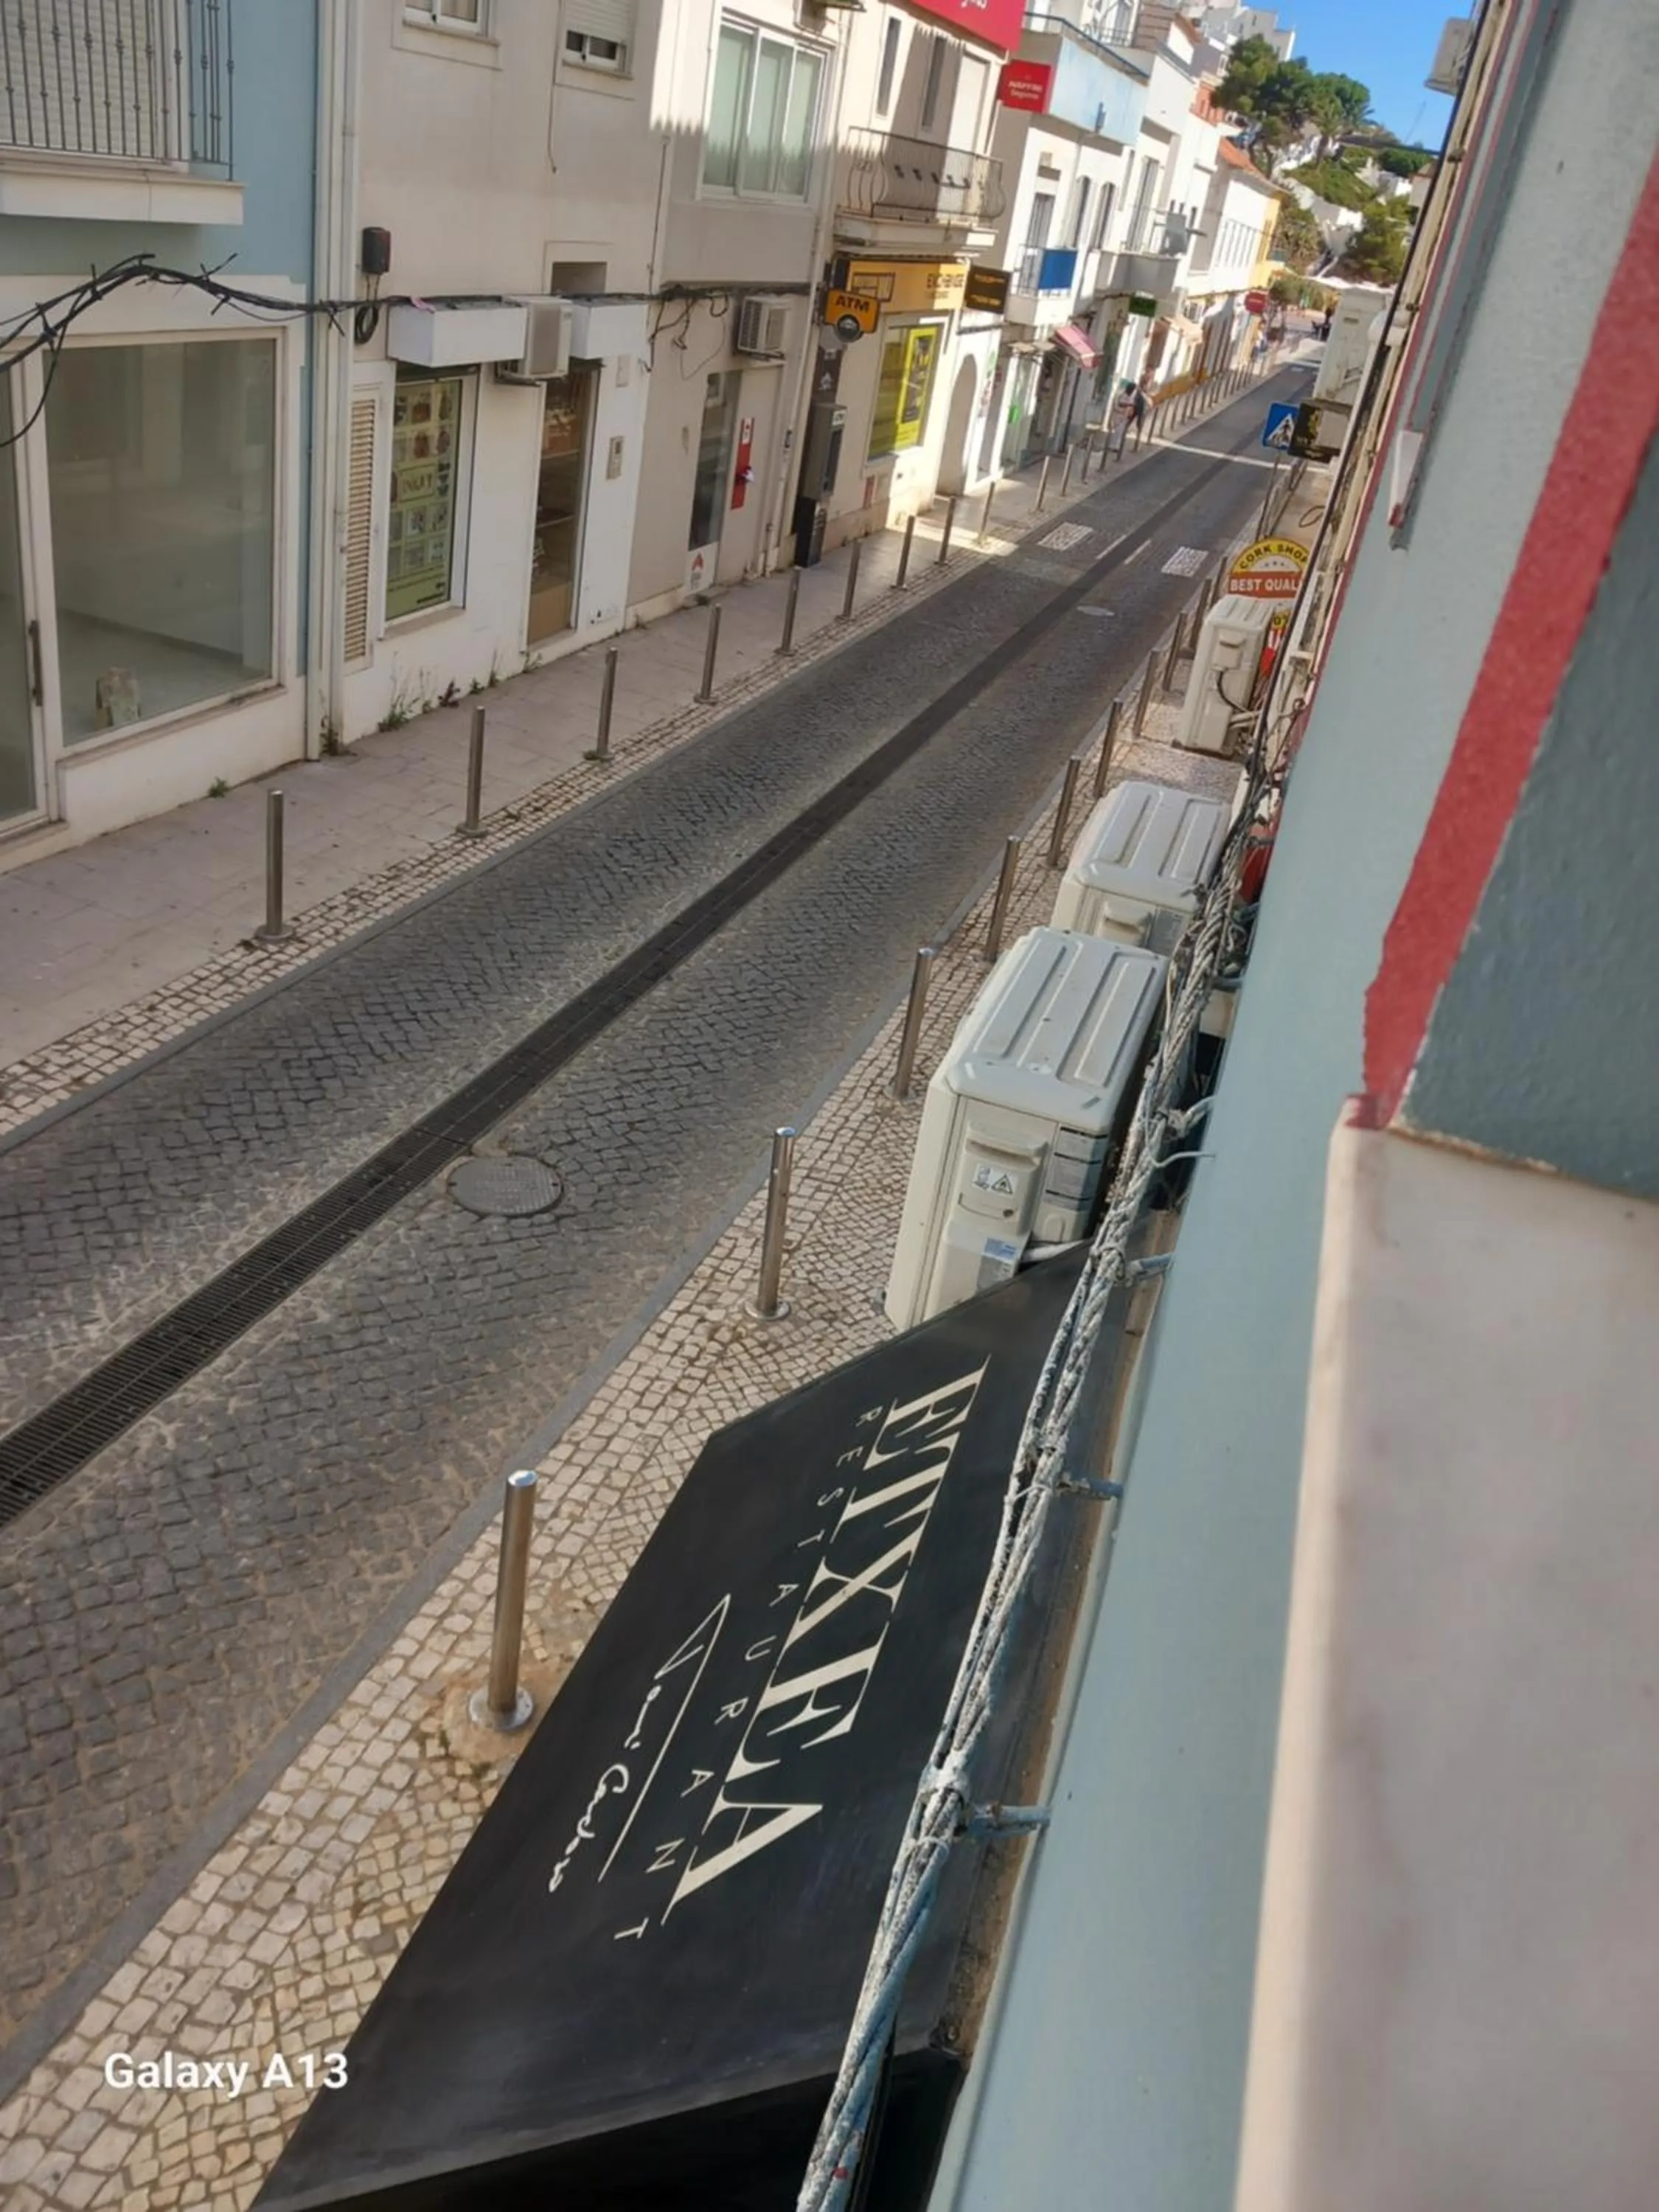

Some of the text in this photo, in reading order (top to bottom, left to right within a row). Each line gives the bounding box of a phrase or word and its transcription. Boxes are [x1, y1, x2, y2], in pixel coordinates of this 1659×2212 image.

[835, 295, 870, 313] ATM
[1239, 545, 1271, 569] CORK
[1231, 578, 1301, 593] BEST QUAL
[661, 1354, 990, 1927] ETXEA
[614, 1406, 883, 1940] RESTAURANT
